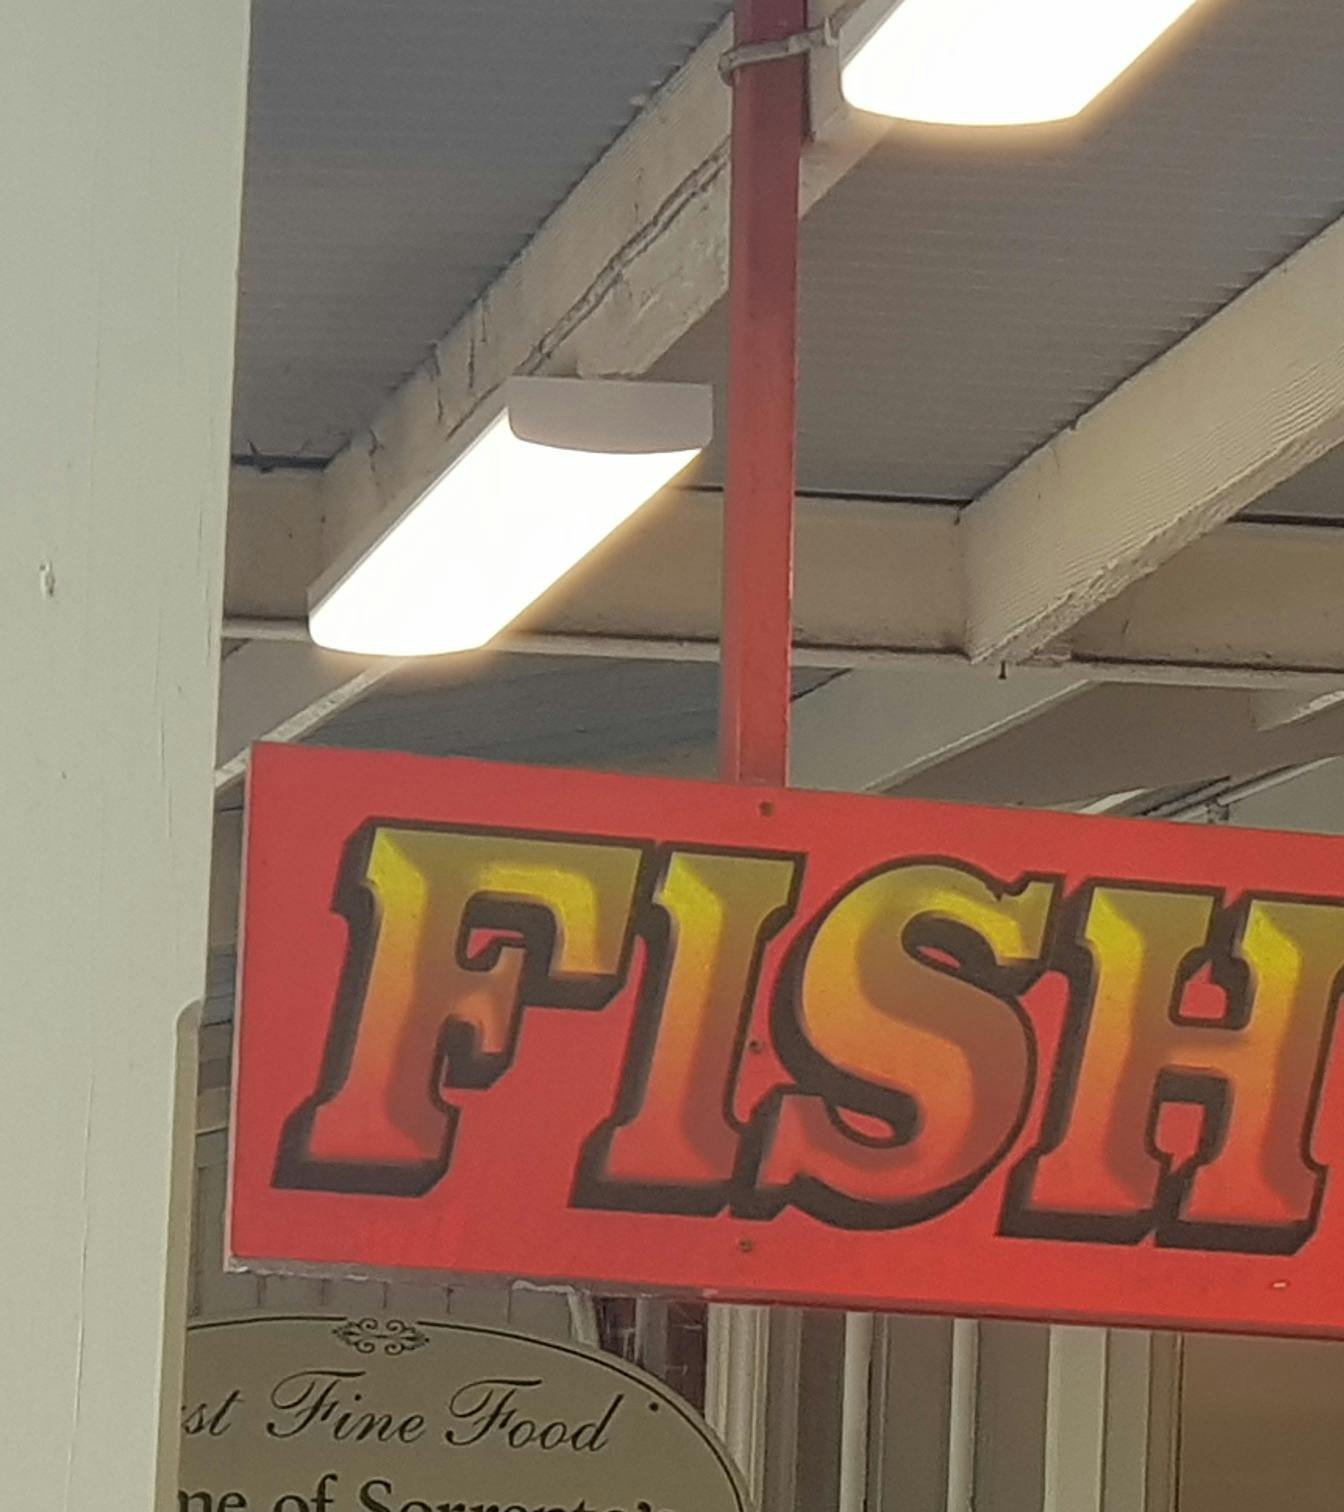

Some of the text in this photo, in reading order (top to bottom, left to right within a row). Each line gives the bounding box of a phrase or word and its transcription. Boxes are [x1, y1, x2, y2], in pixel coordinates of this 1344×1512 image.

[180, 1369, 624, 1453] st Fine Food
